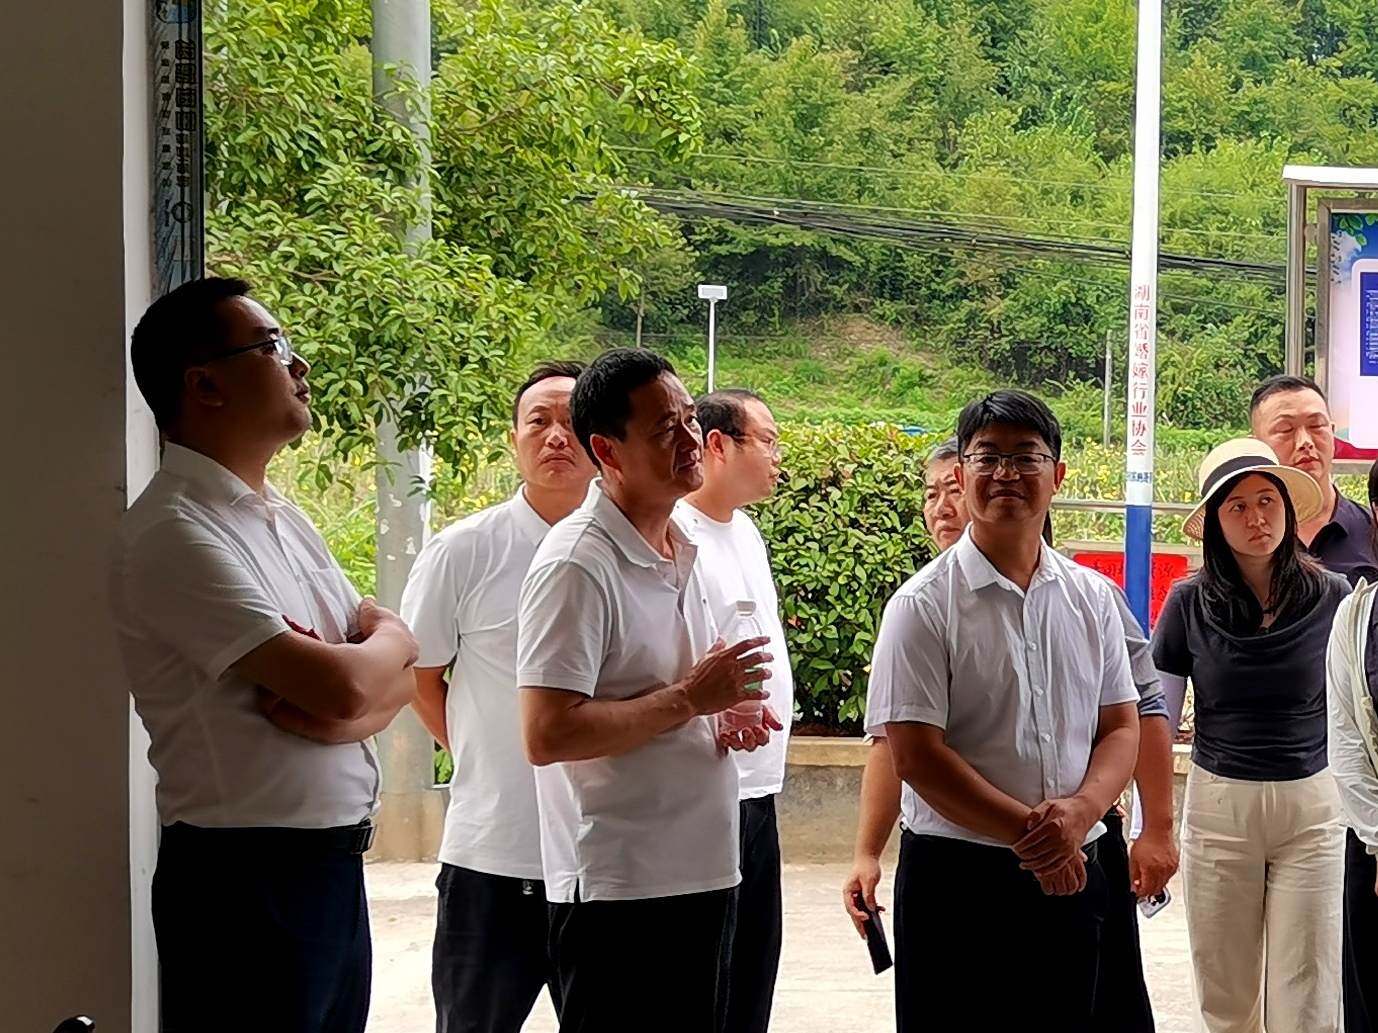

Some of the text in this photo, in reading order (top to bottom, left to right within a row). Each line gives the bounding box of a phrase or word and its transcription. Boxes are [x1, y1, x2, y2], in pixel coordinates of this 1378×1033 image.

[1131, 284, 1151, 456] 湖南省婚嫁行业协会
